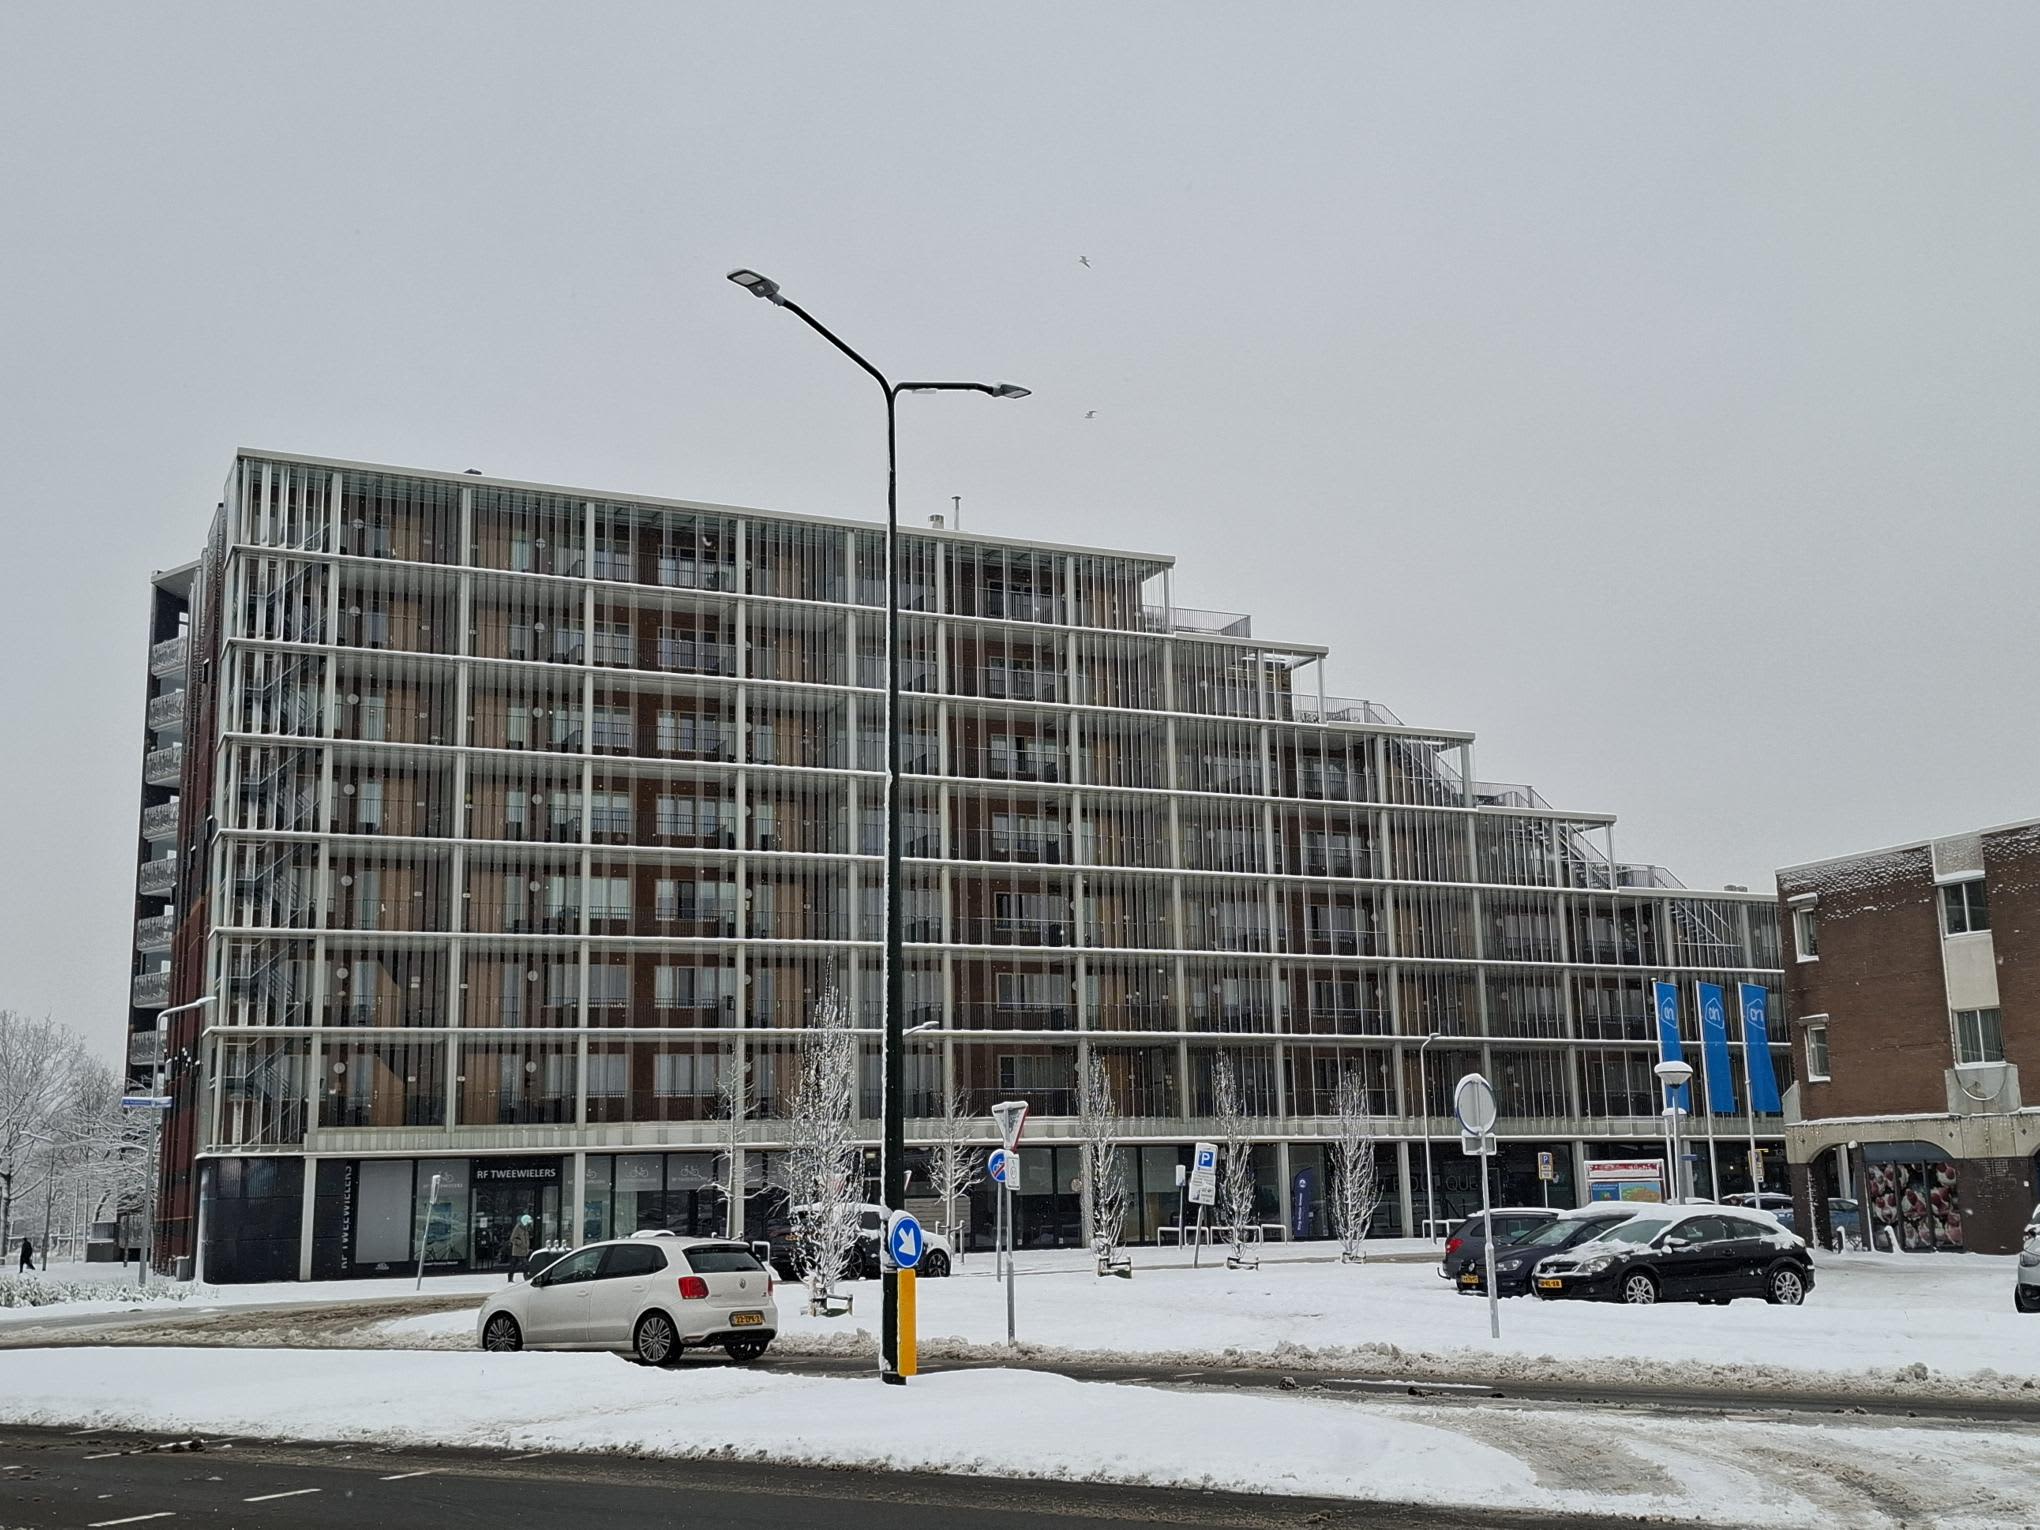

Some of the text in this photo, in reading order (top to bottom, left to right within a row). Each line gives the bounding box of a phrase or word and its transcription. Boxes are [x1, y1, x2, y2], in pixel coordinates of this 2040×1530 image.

[1201, 1152, 1211, 1165] P
[477, 1168, 556, 1179] RF TWEEWIELERS
